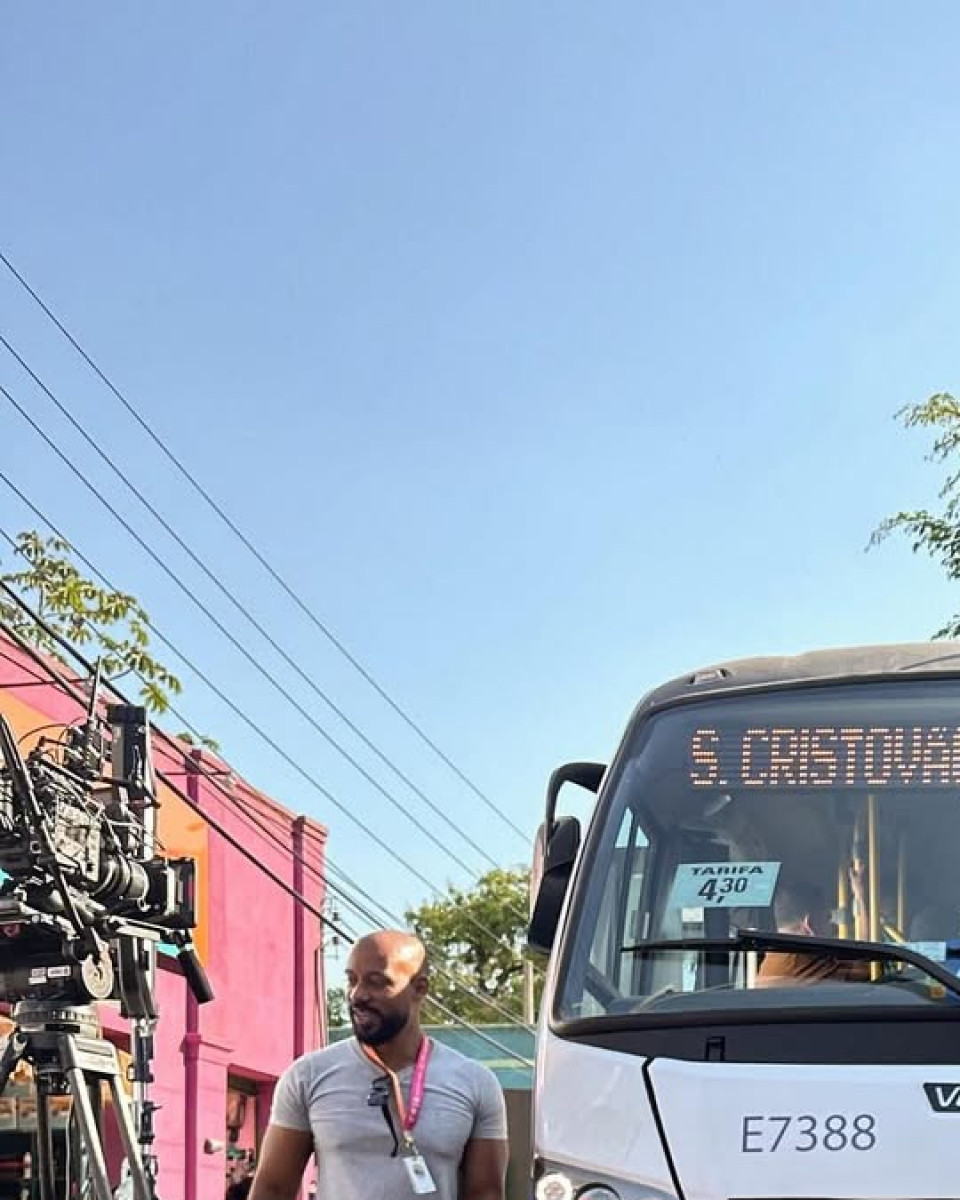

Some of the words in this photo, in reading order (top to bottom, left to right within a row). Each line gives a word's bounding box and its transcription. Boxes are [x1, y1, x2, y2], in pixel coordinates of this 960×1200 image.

[690, 729, 728, 786] S.
[691, 865, 764, 875] TARIFA
[741, 1114, 876, 1153] E7388
